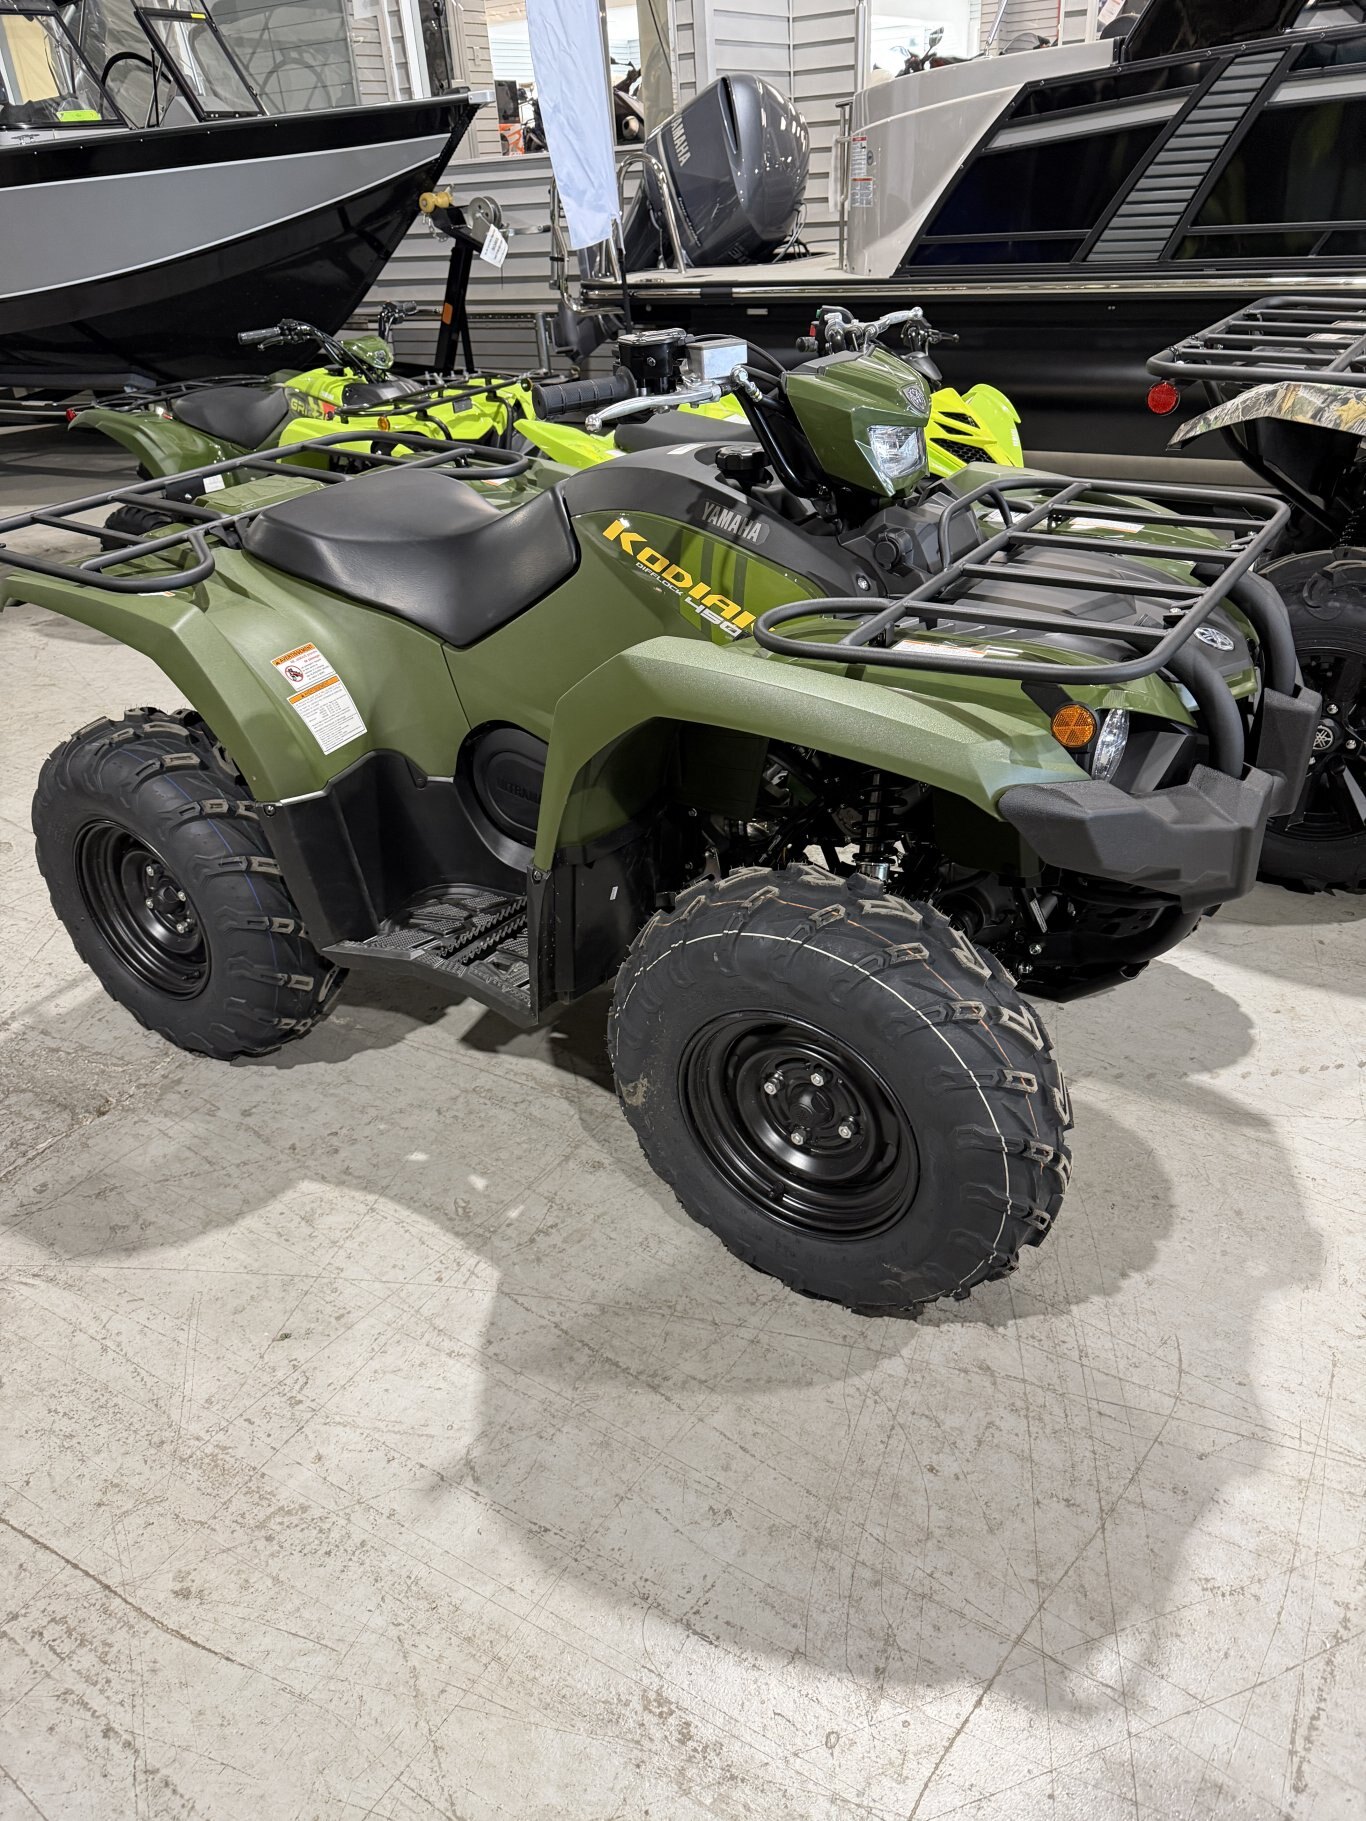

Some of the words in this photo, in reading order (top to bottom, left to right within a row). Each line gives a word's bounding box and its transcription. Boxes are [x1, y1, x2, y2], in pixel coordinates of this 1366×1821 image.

[701, 501, 763, 543] YAMAHA
[635, 562, 683, 596] DIFFLOCK
[684, 596, 742, 638] 450
